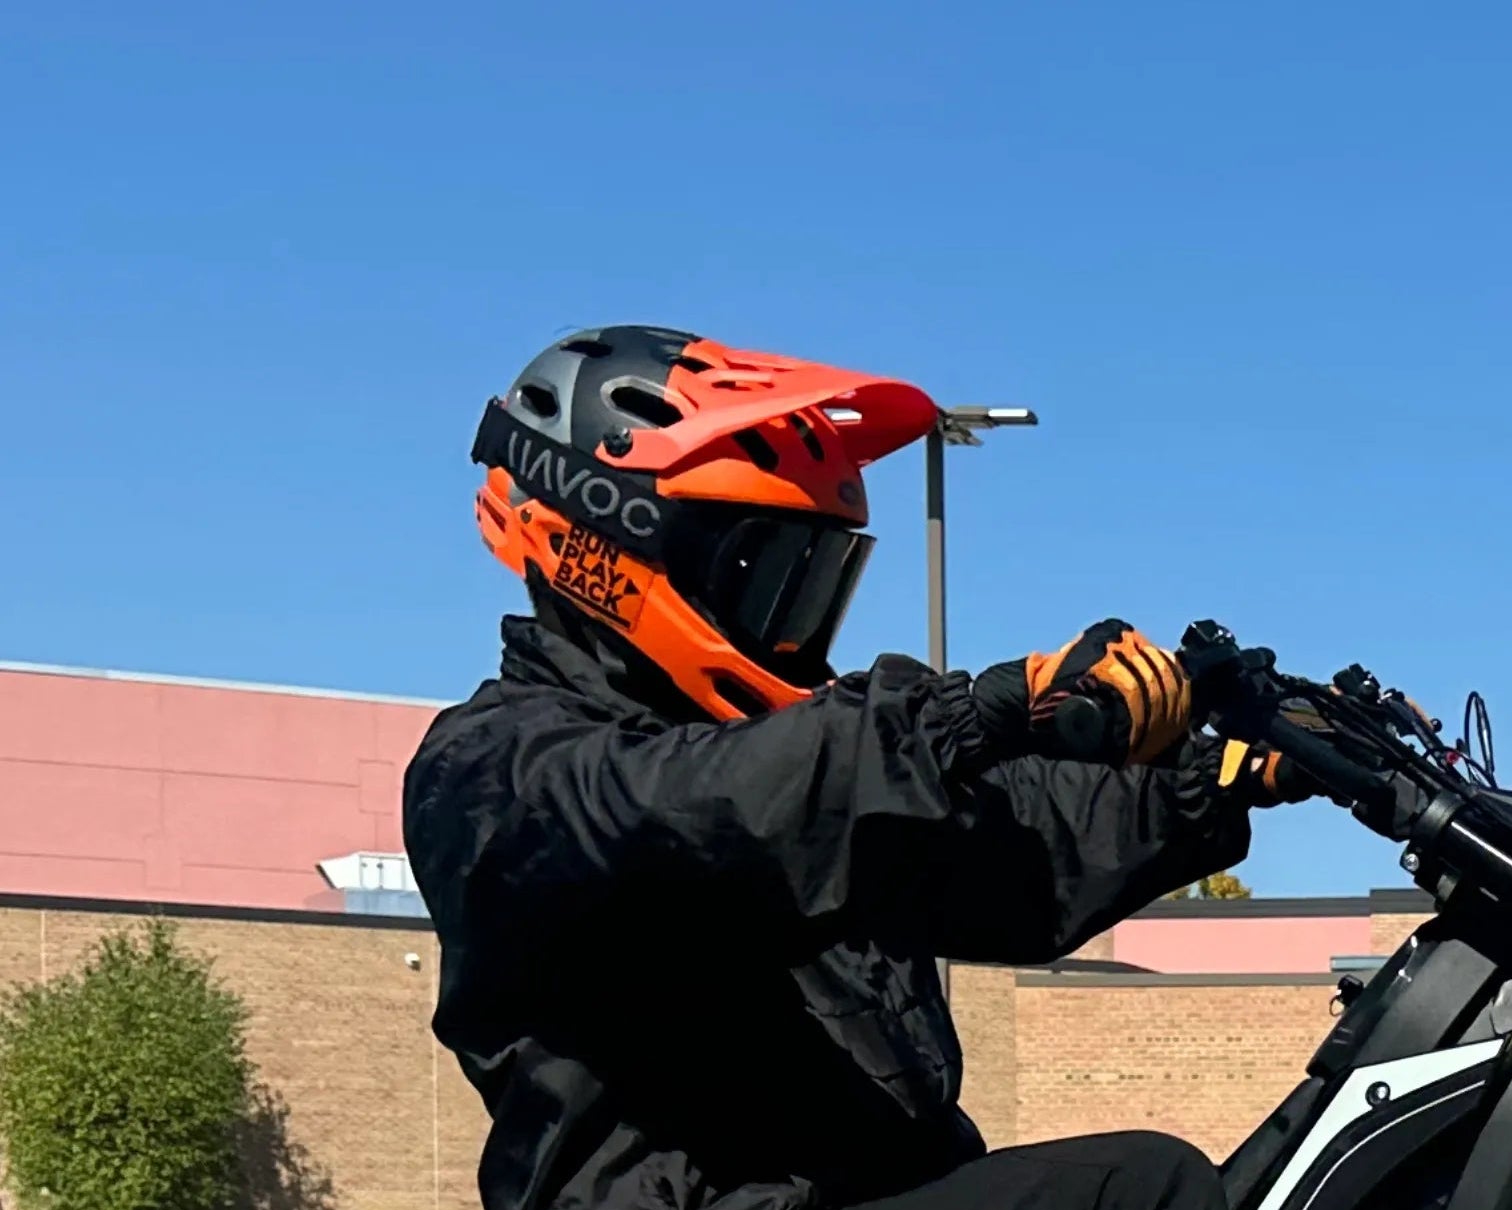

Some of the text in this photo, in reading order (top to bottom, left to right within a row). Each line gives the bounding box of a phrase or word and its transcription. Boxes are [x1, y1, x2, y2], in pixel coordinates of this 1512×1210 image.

[562, 543, 625, 587] PLAY
[569, 528, 619, 564] RUN
[556, 560, 623, 613] BACK
